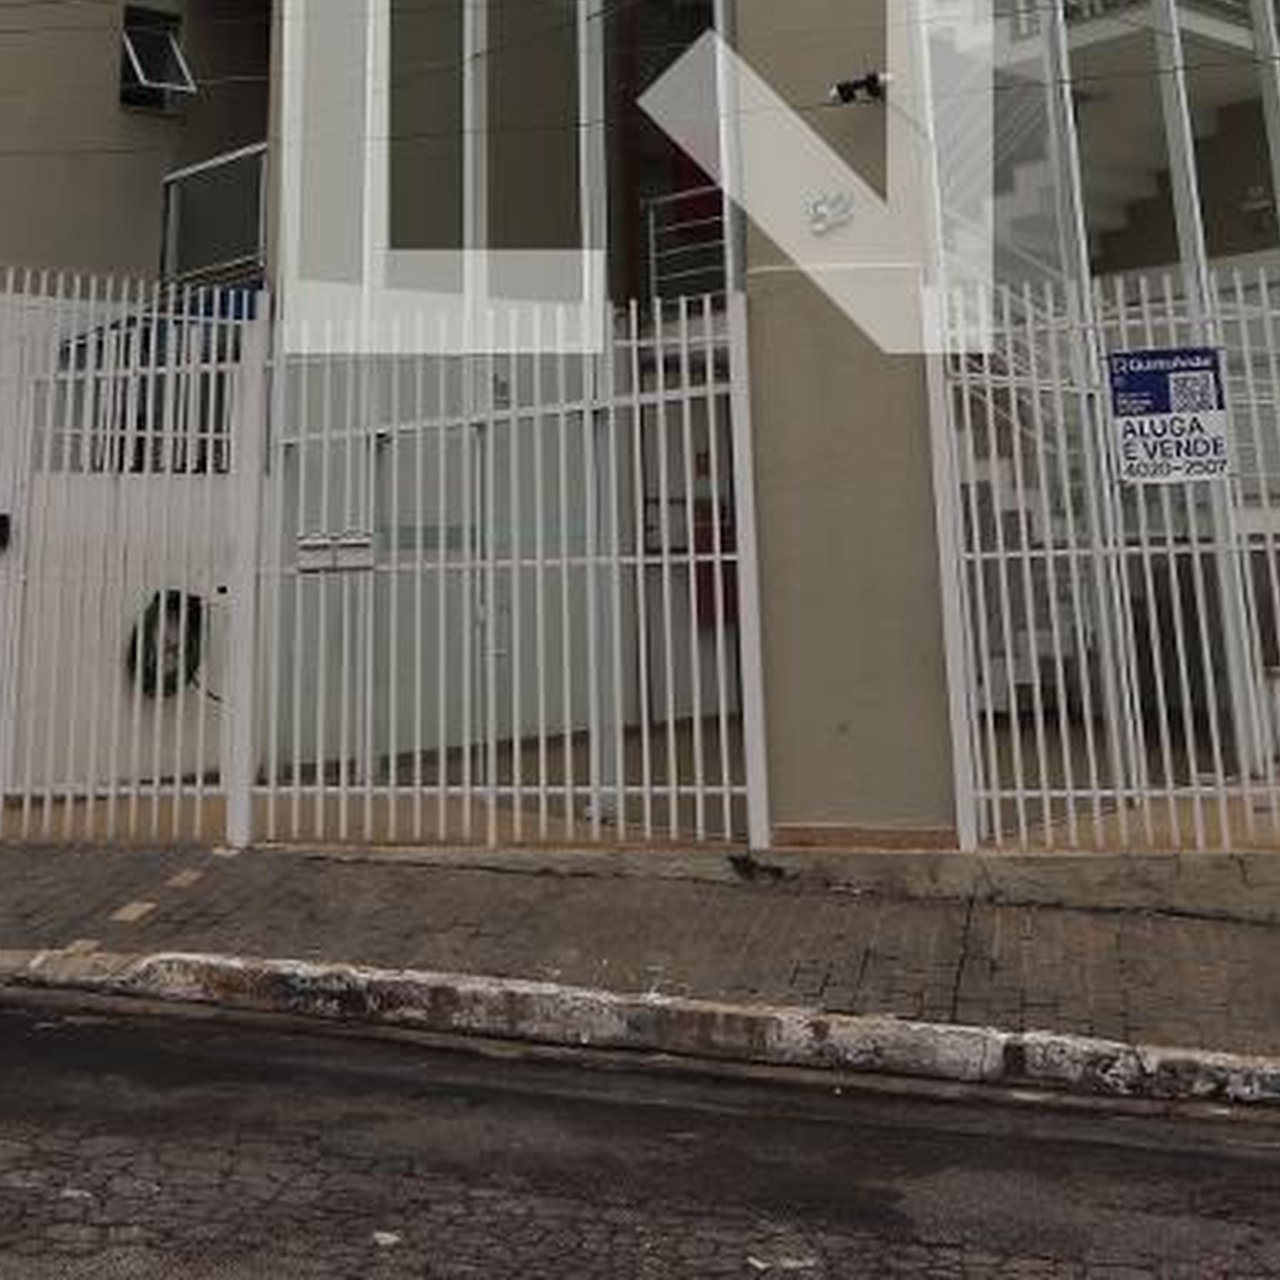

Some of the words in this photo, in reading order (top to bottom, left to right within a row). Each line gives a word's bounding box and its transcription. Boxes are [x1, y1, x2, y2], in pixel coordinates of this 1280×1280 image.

[1122, 416, 1205, 439] ALUGA
[1124, 441, 1138, 461] E
[1142, 437, 1225, 460] VENDE
